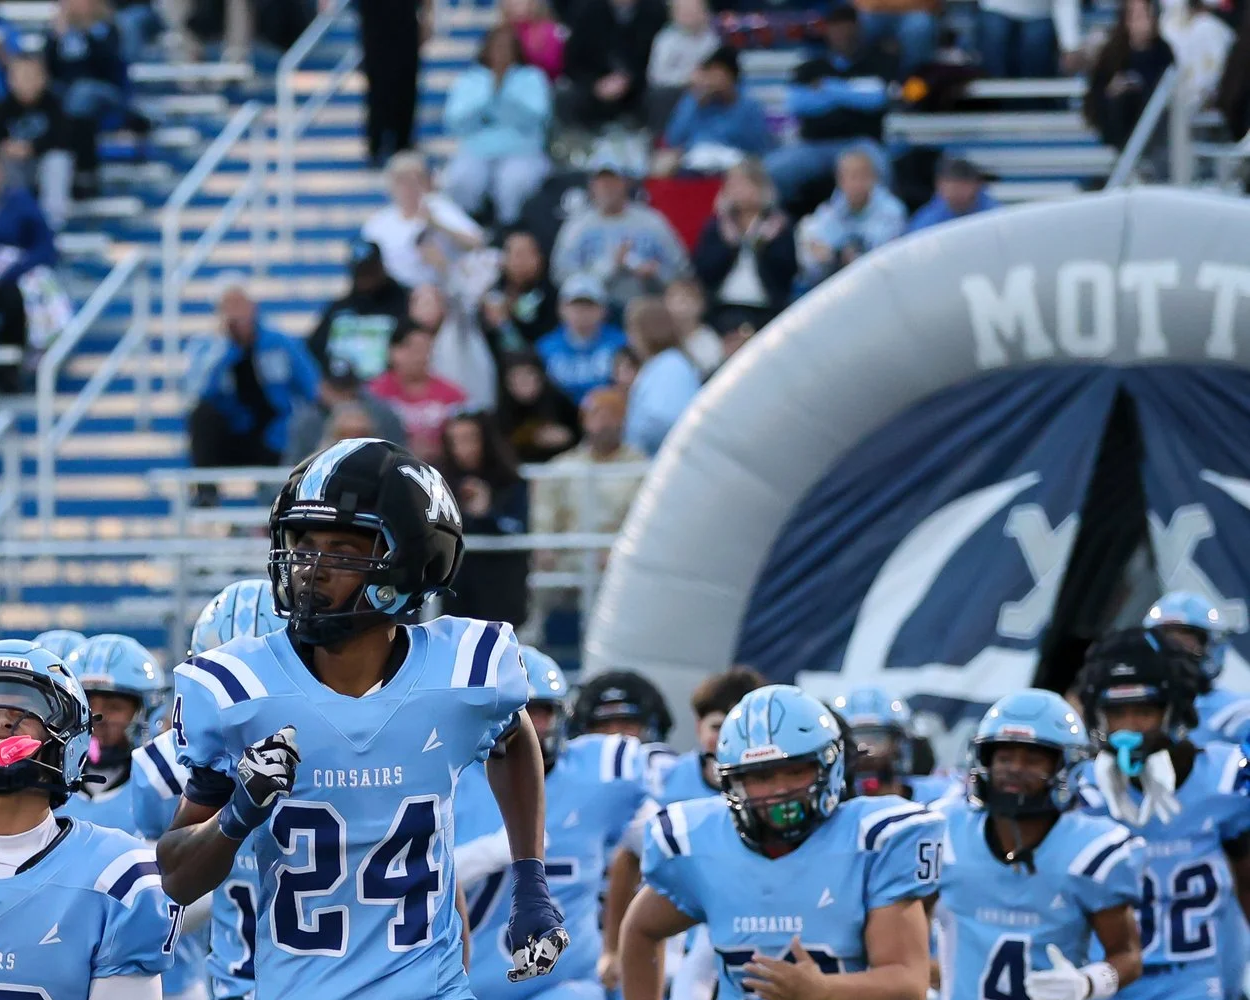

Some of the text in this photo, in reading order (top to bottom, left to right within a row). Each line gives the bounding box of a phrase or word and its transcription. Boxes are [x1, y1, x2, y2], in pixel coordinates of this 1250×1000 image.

[960, 260, 1250, 368] MOTT
[312, 766, 405, 788] CORSAIRS
[267, 792, 443, 958] 24
[915, 838, 943, 885] 5
[162, 904, 187, 955] 7
[733, 915, 804, 933] CORSAIRS
